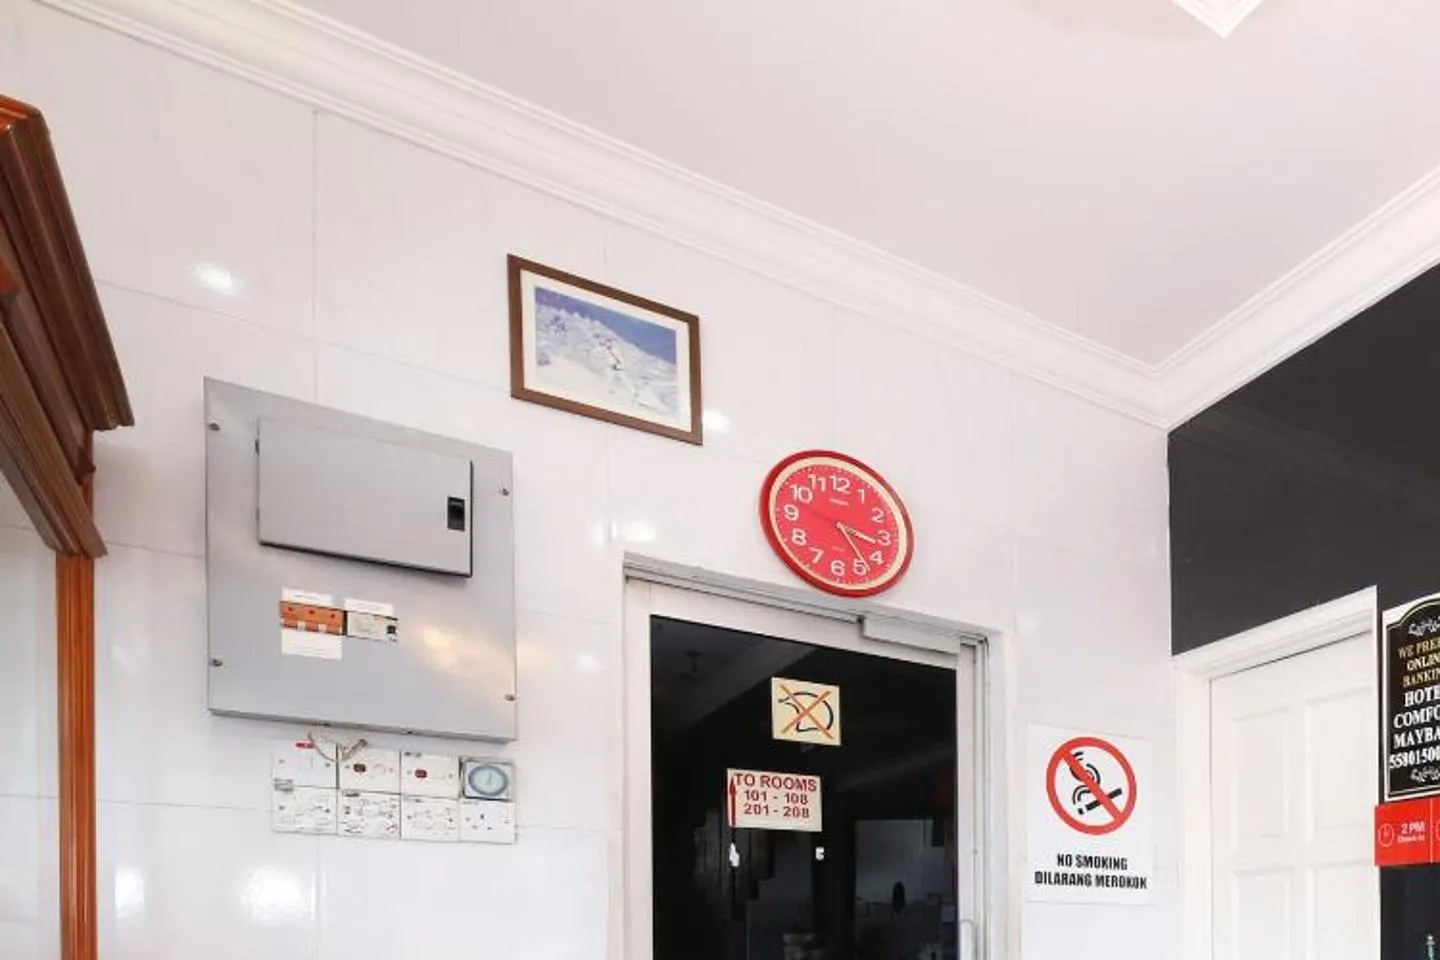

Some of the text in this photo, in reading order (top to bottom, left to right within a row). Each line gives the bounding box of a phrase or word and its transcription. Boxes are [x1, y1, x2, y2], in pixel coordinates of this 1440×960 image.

[808, 474, 826, 492] 11
[830, 475, 851, 494] 12
[789, 485, 813, 504] 10
[858, 489, 865, 504] 1
[784, 504, 799, 521] 9
[871, 507, 884, 523] 2
[791, 527, 807, 546] 8
[877, 529, 892, 546] 3
[809, 548, 824, 564] 7
[869, 550, 884, 565] 4
[831, 559, 845, 576] 6
[853, 558, 867, 576] 5
[1398, 644, 1414, 658] WE
[734, 773, 816, 792] TO ROOMS
[744, 789, 767, 801] 101
[785, 793, 808, 805] 108
[744, 803, 769, 815] 201
[1401, 821, 1425, 834] 2 PM
[1057, 853, 1128, 871] NO SMOKING
[1034, 871, 1147, 890] DILARANG MEROKOK
